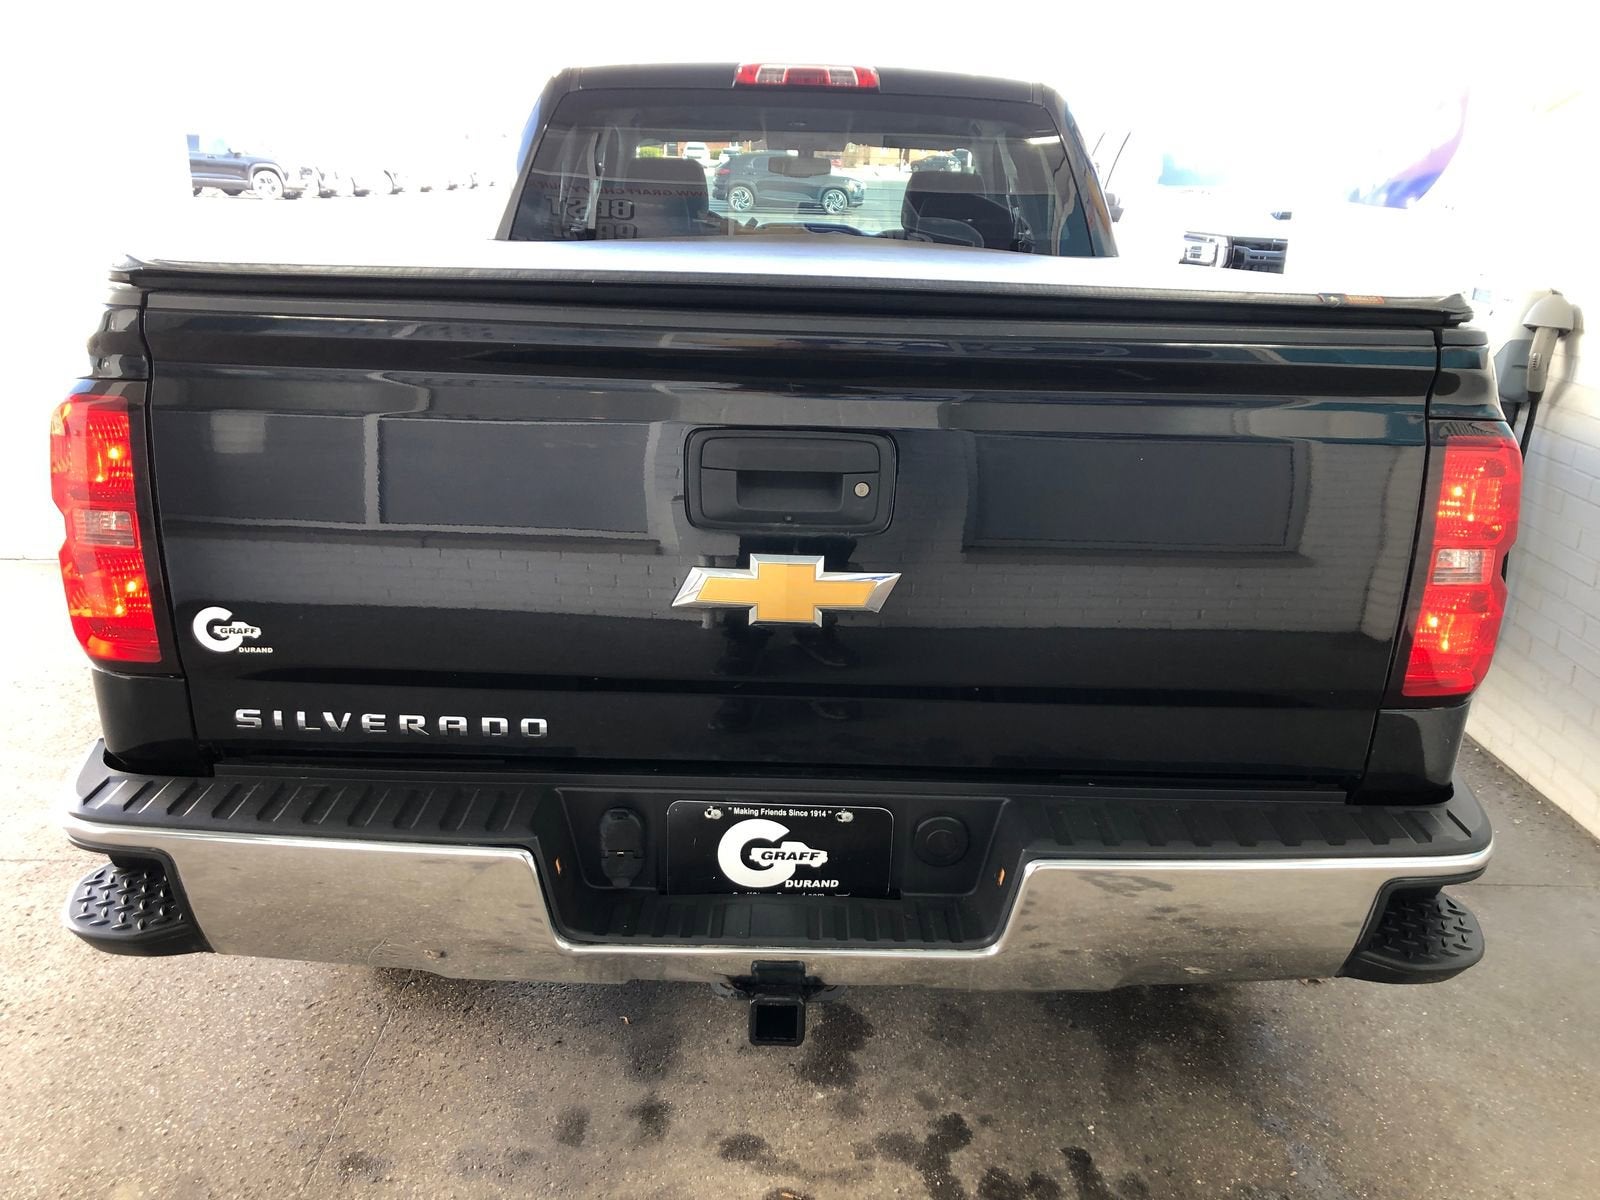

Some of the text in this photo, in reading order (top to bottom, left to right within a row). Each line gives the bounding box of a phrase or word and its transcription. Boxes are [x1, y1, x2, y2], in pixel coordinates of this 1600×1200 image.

[220, 627, 257, 635] GRAFF
[234, 708, 548, 737] SILVERADO
[760, 808, 787, 816] Friends
[788, 809, 808, 817] Since
[760, 850, 821, 861] GRAFF
[785, 879, 840, 888] DURAND
